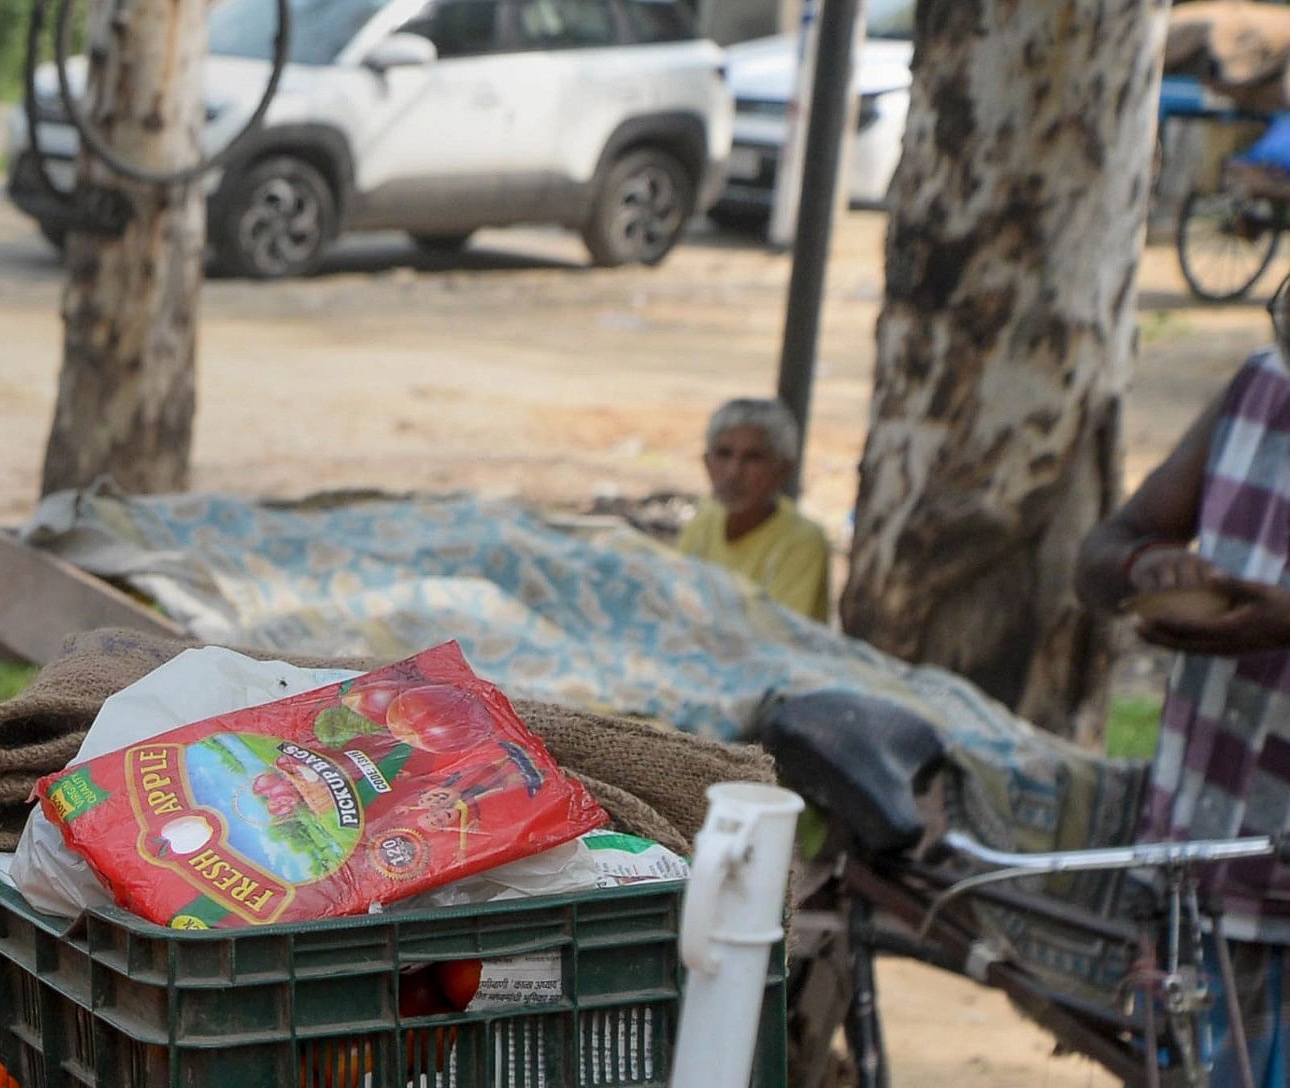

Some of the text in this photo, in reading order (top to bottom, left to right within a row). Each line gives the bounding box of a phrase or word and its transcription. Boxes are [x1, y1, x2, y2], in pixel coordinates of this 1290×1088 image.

[283, 745, 359, 825] PICKUP BAGS
[139, 749, 273, 912] FRESH APPLE
[382, 839, 406, 866] 120
